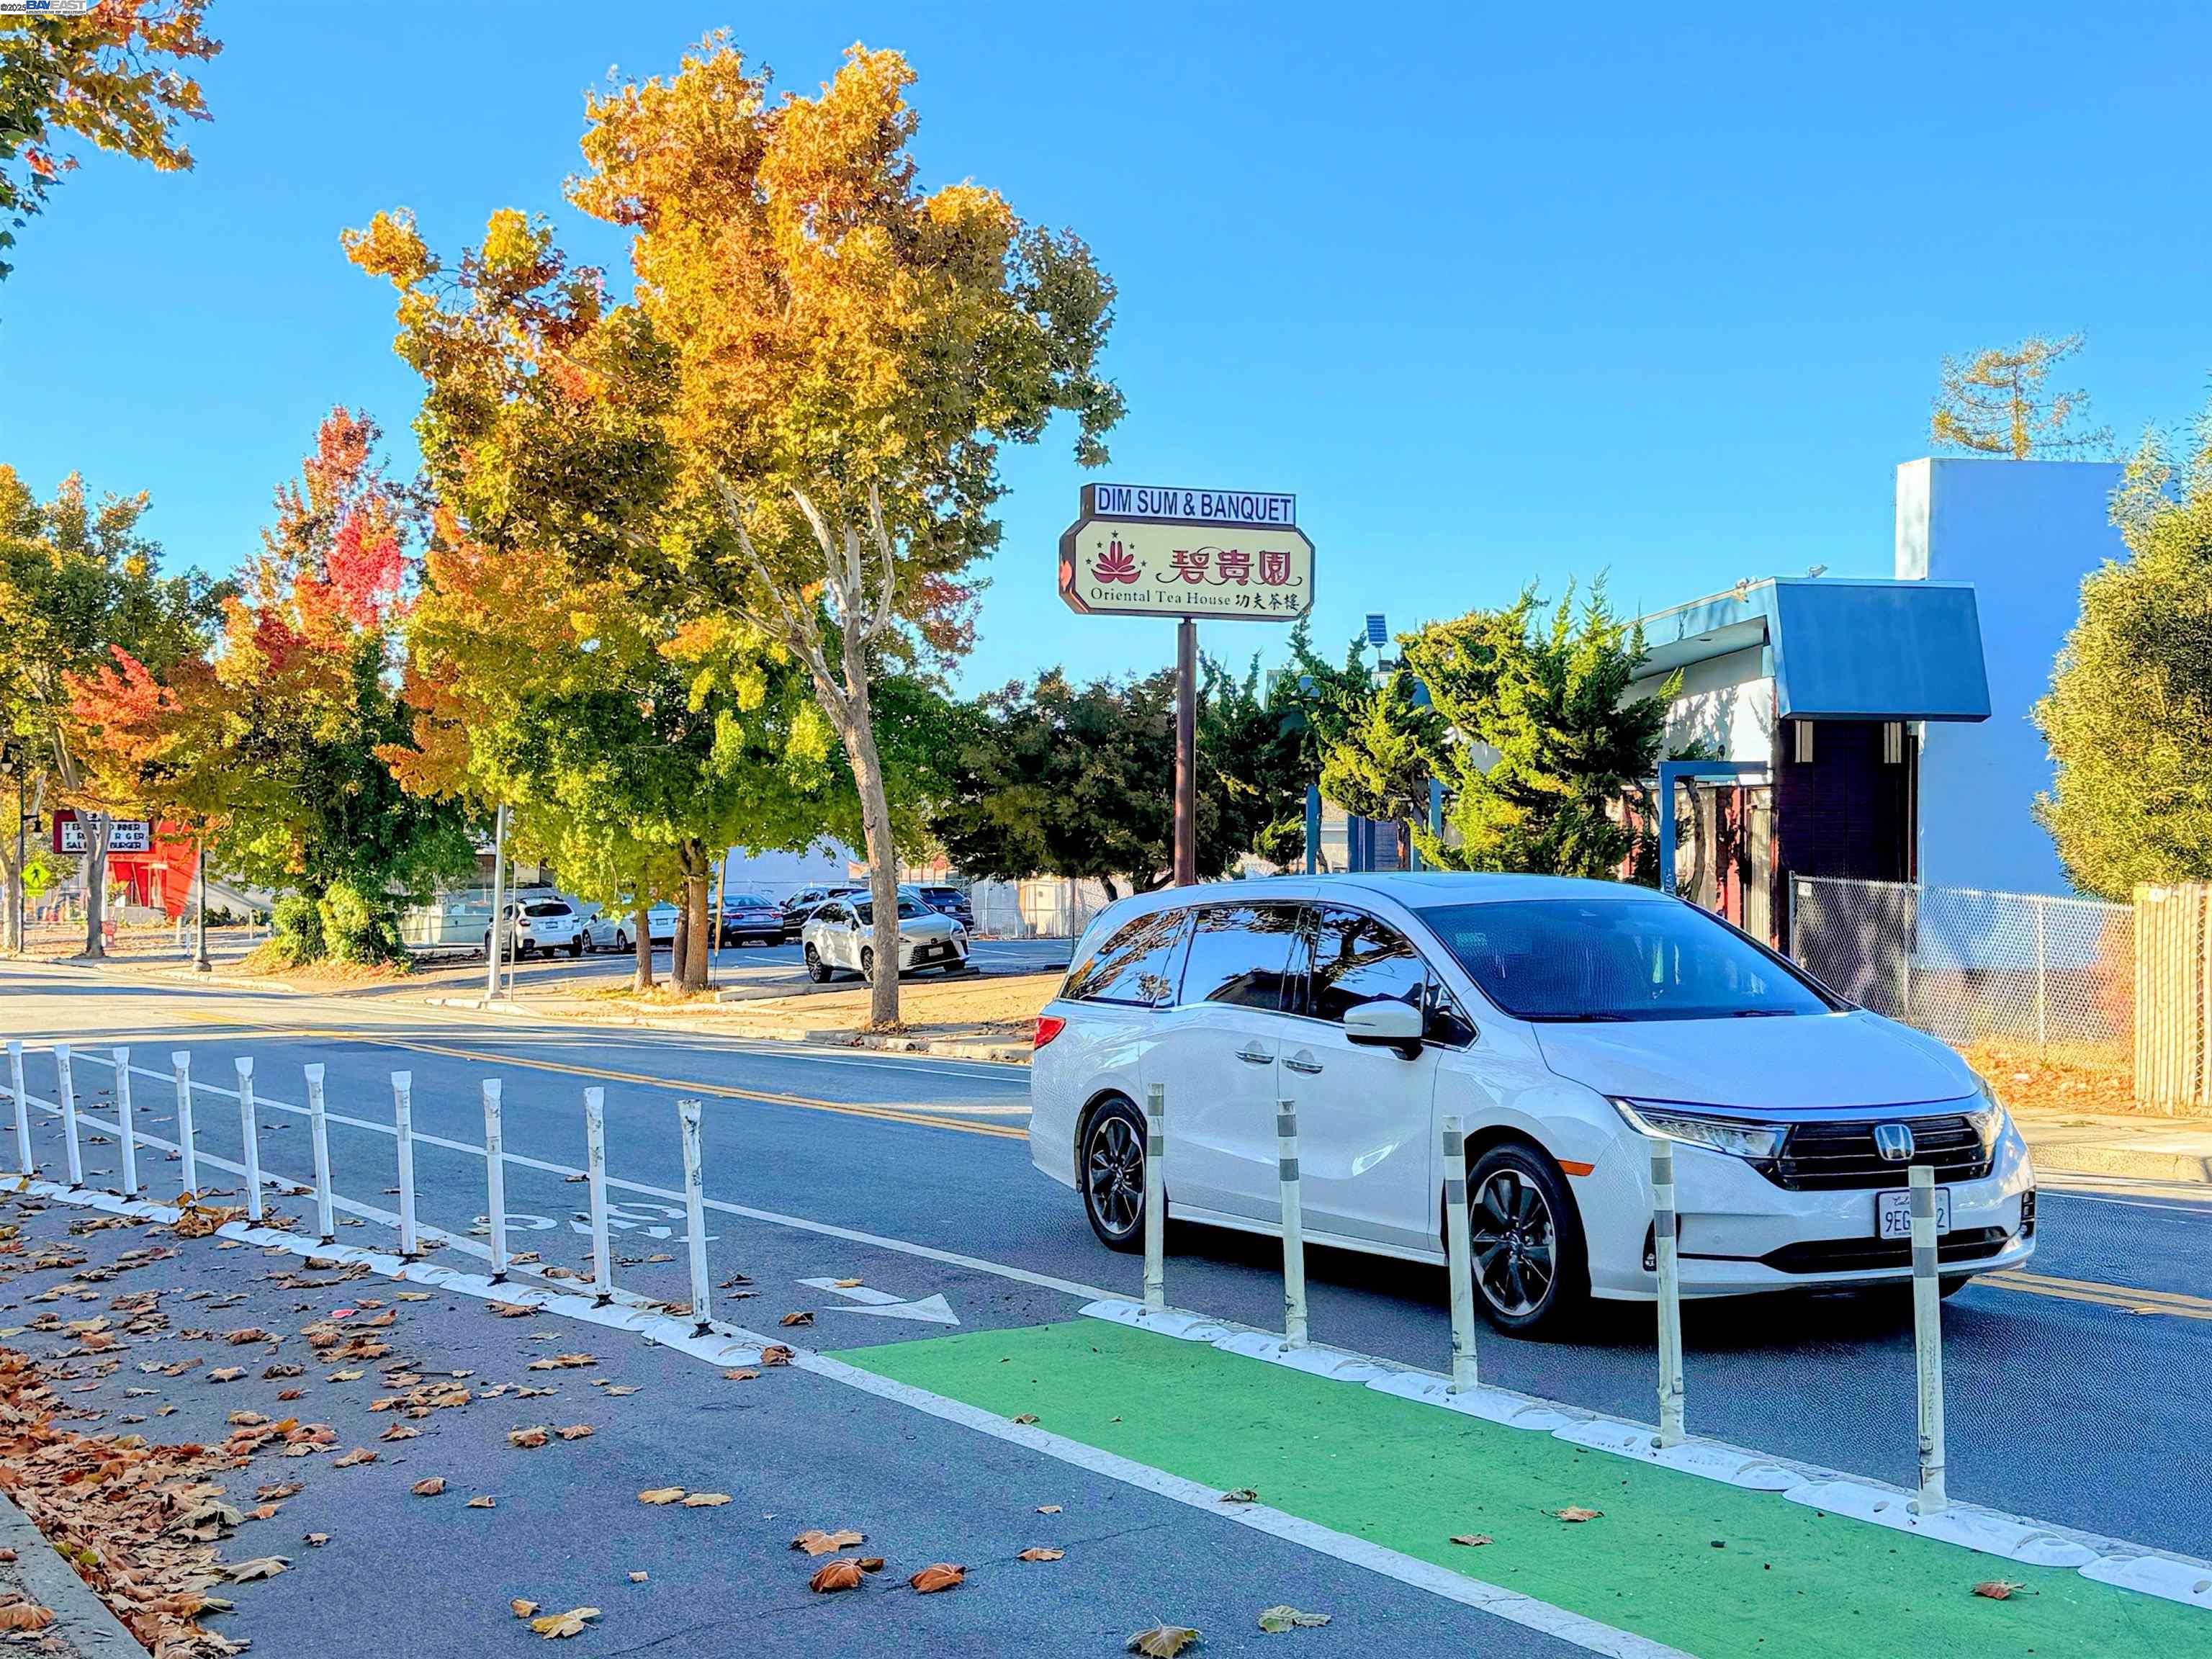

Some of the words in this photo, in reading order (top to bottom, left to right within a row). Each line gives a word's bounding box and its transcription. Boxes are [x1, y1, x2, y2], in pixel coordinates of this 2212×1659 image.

[1099, 487, 1131, 513] DIM
[1138, 490, 1177, 516] SUM
[1183, 493, 1195, 516] &
[1201, 493, 1291, 522] BANQUET
[1091, 588, 1150, 602] Oriental
[1156, 590, 1181, 603] Tea
[1187, 592, 1231, 606] House
[1885, 1208, 1946, 1233] 9EG2
